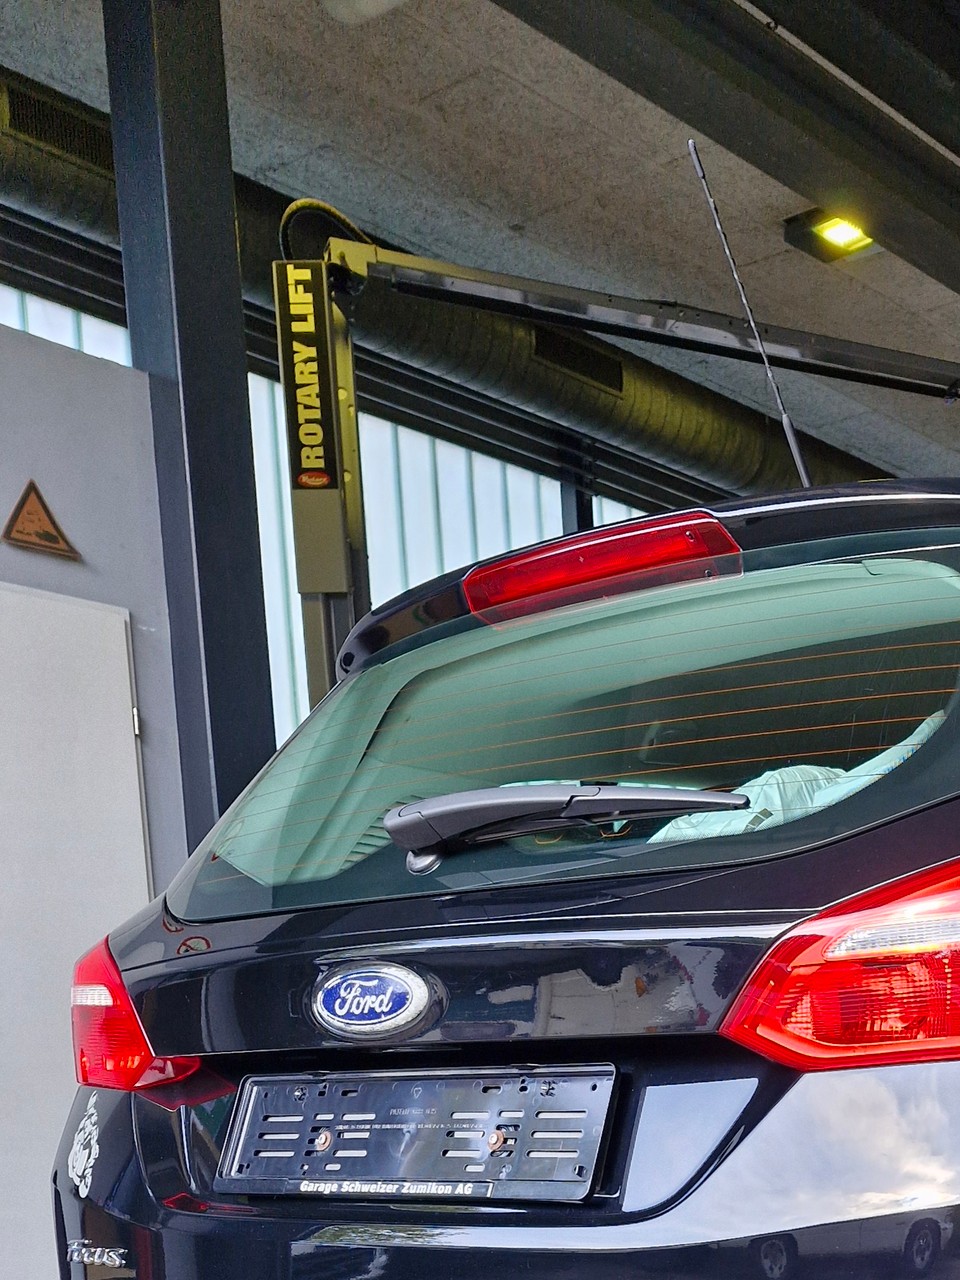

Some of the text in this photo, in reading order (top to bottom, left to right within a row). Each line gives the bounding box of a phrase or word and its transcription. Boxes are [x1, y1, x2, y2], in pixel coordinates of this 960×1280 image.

[286, 264, 325, 469] ROTARY LIFT
[334, 979, 393, 1016] Ford
[299, 1180, 473, 1195] Garage Schweizer Zumikon AG
